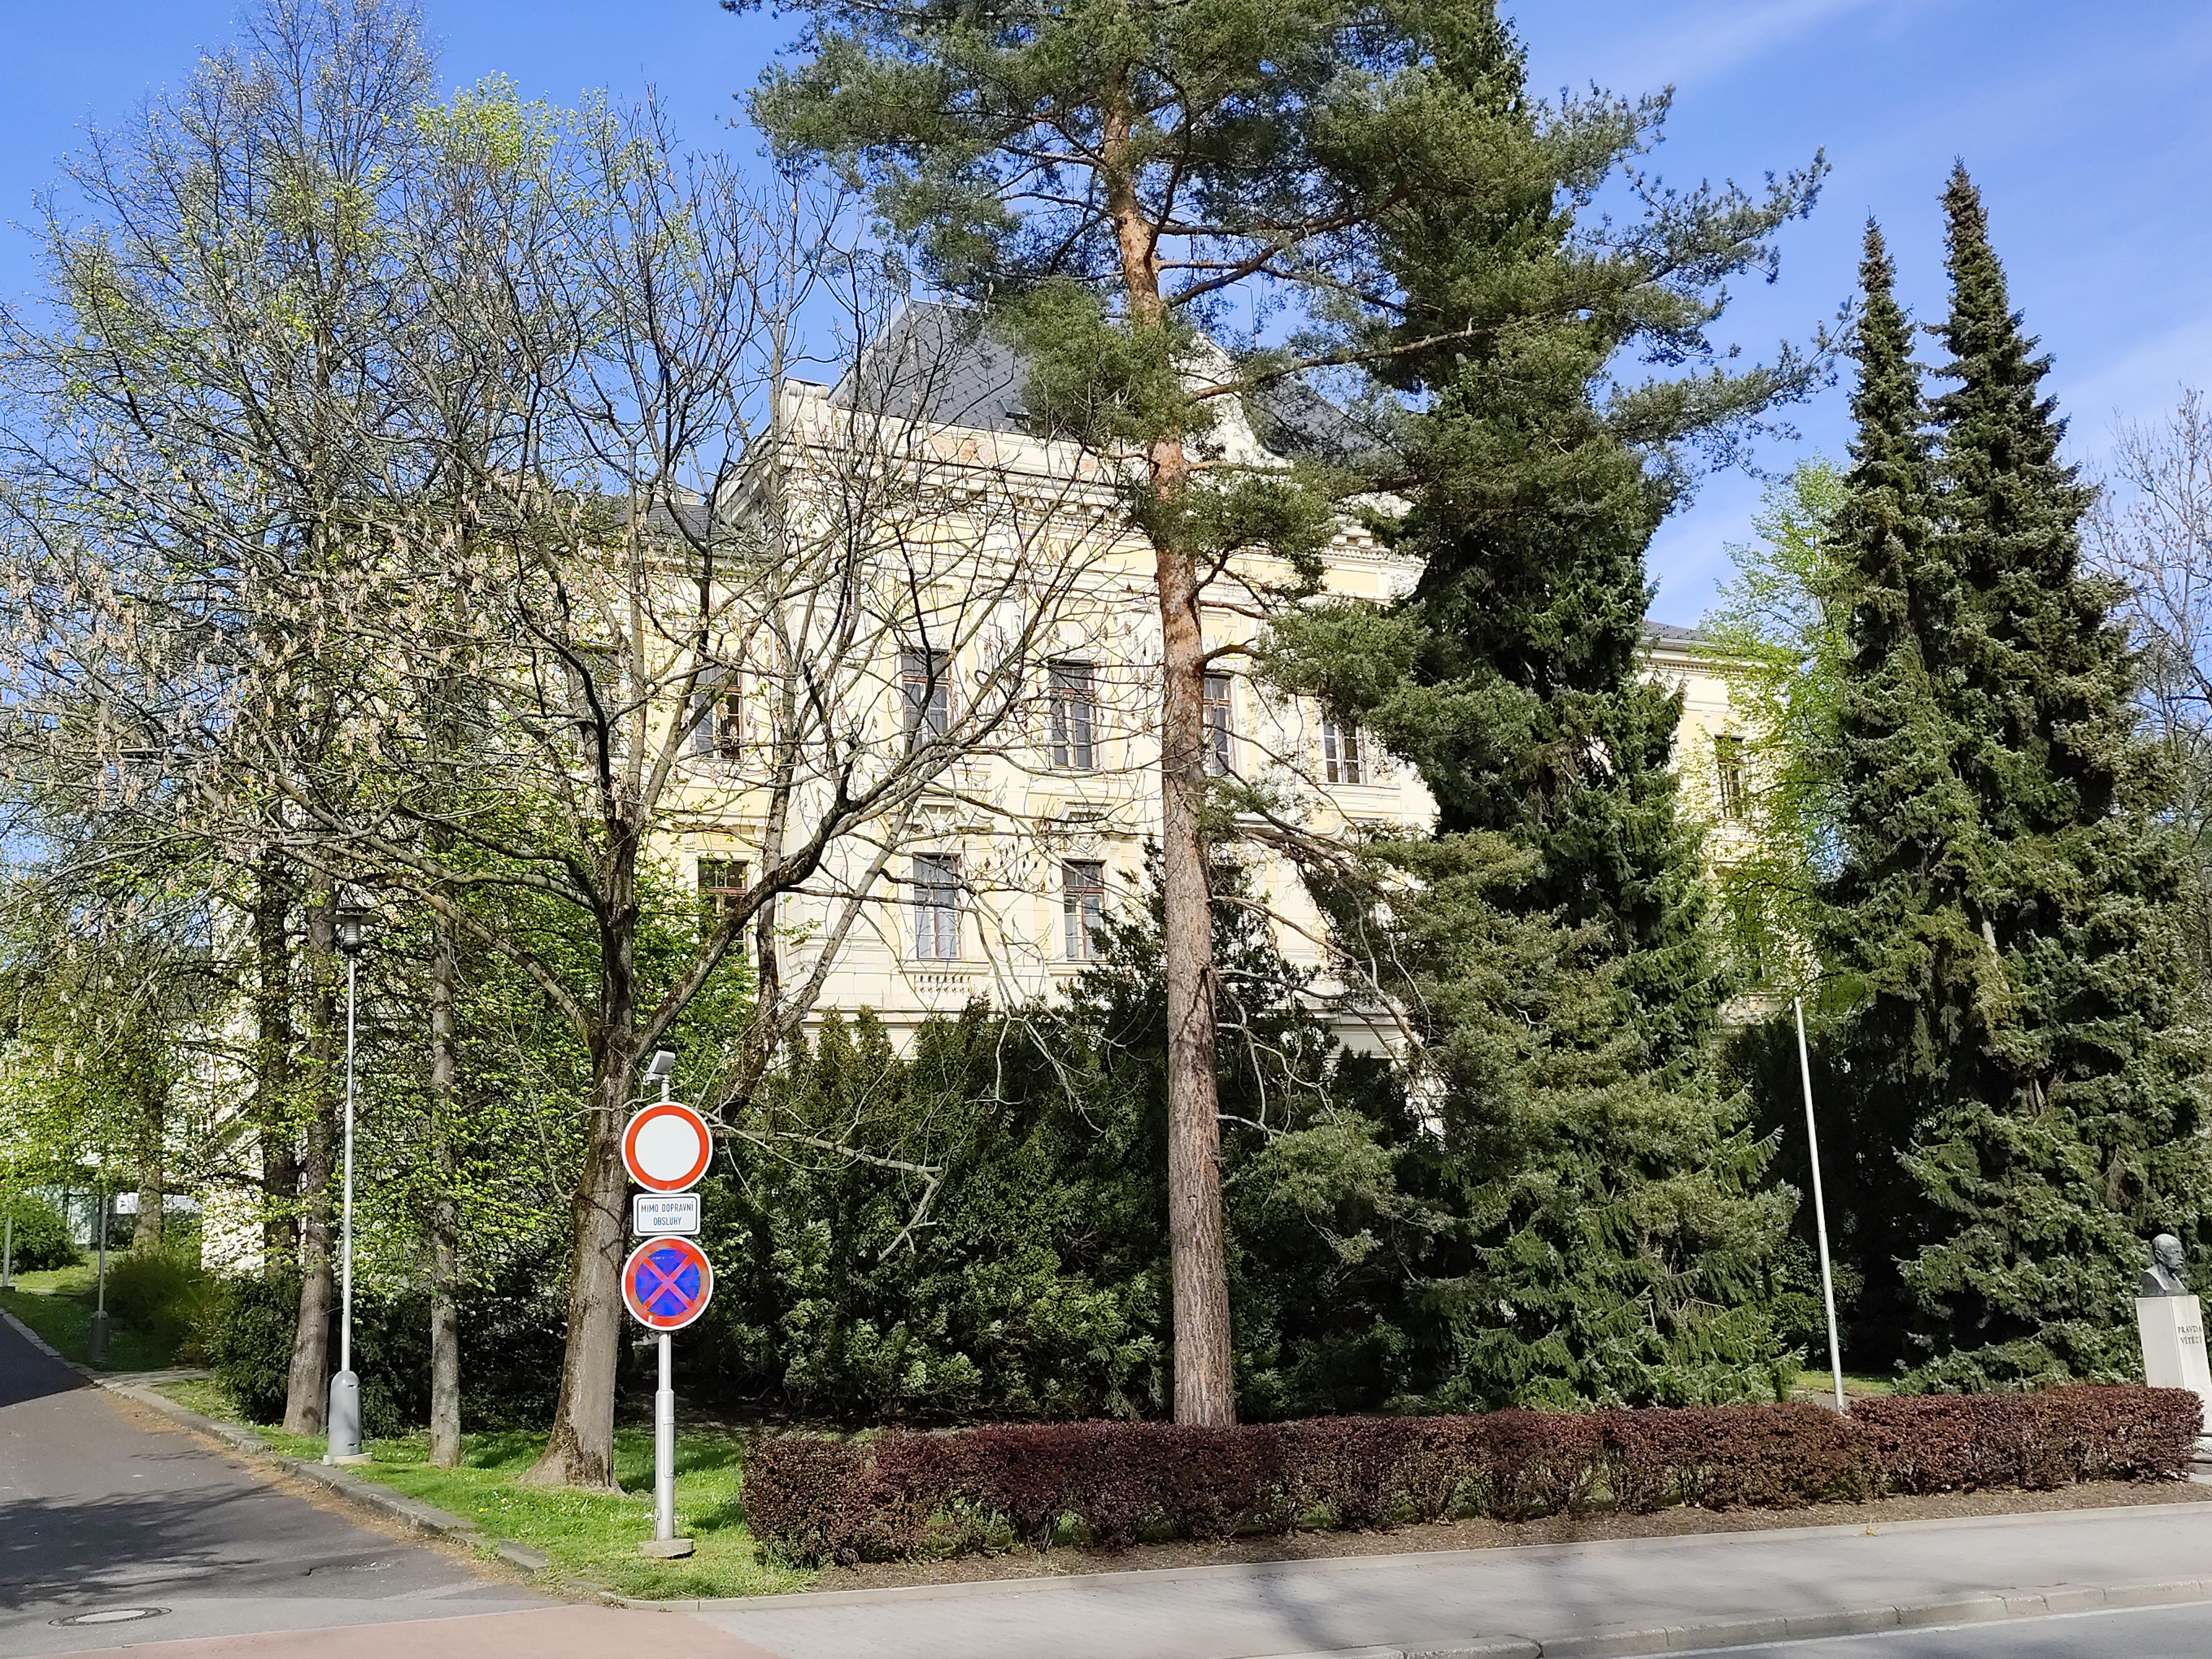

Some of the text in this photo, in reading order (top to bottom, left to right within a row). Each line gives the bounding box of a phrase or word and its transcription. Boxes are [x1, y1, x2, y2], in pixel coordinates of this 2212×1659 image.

[641, 1201, 693, 1213] MIMO DOPRAVNÍ
[653, 1217, 682, 1226] OBSLUHY
[2177, 1325, 2202, 1333] PRAVDA
